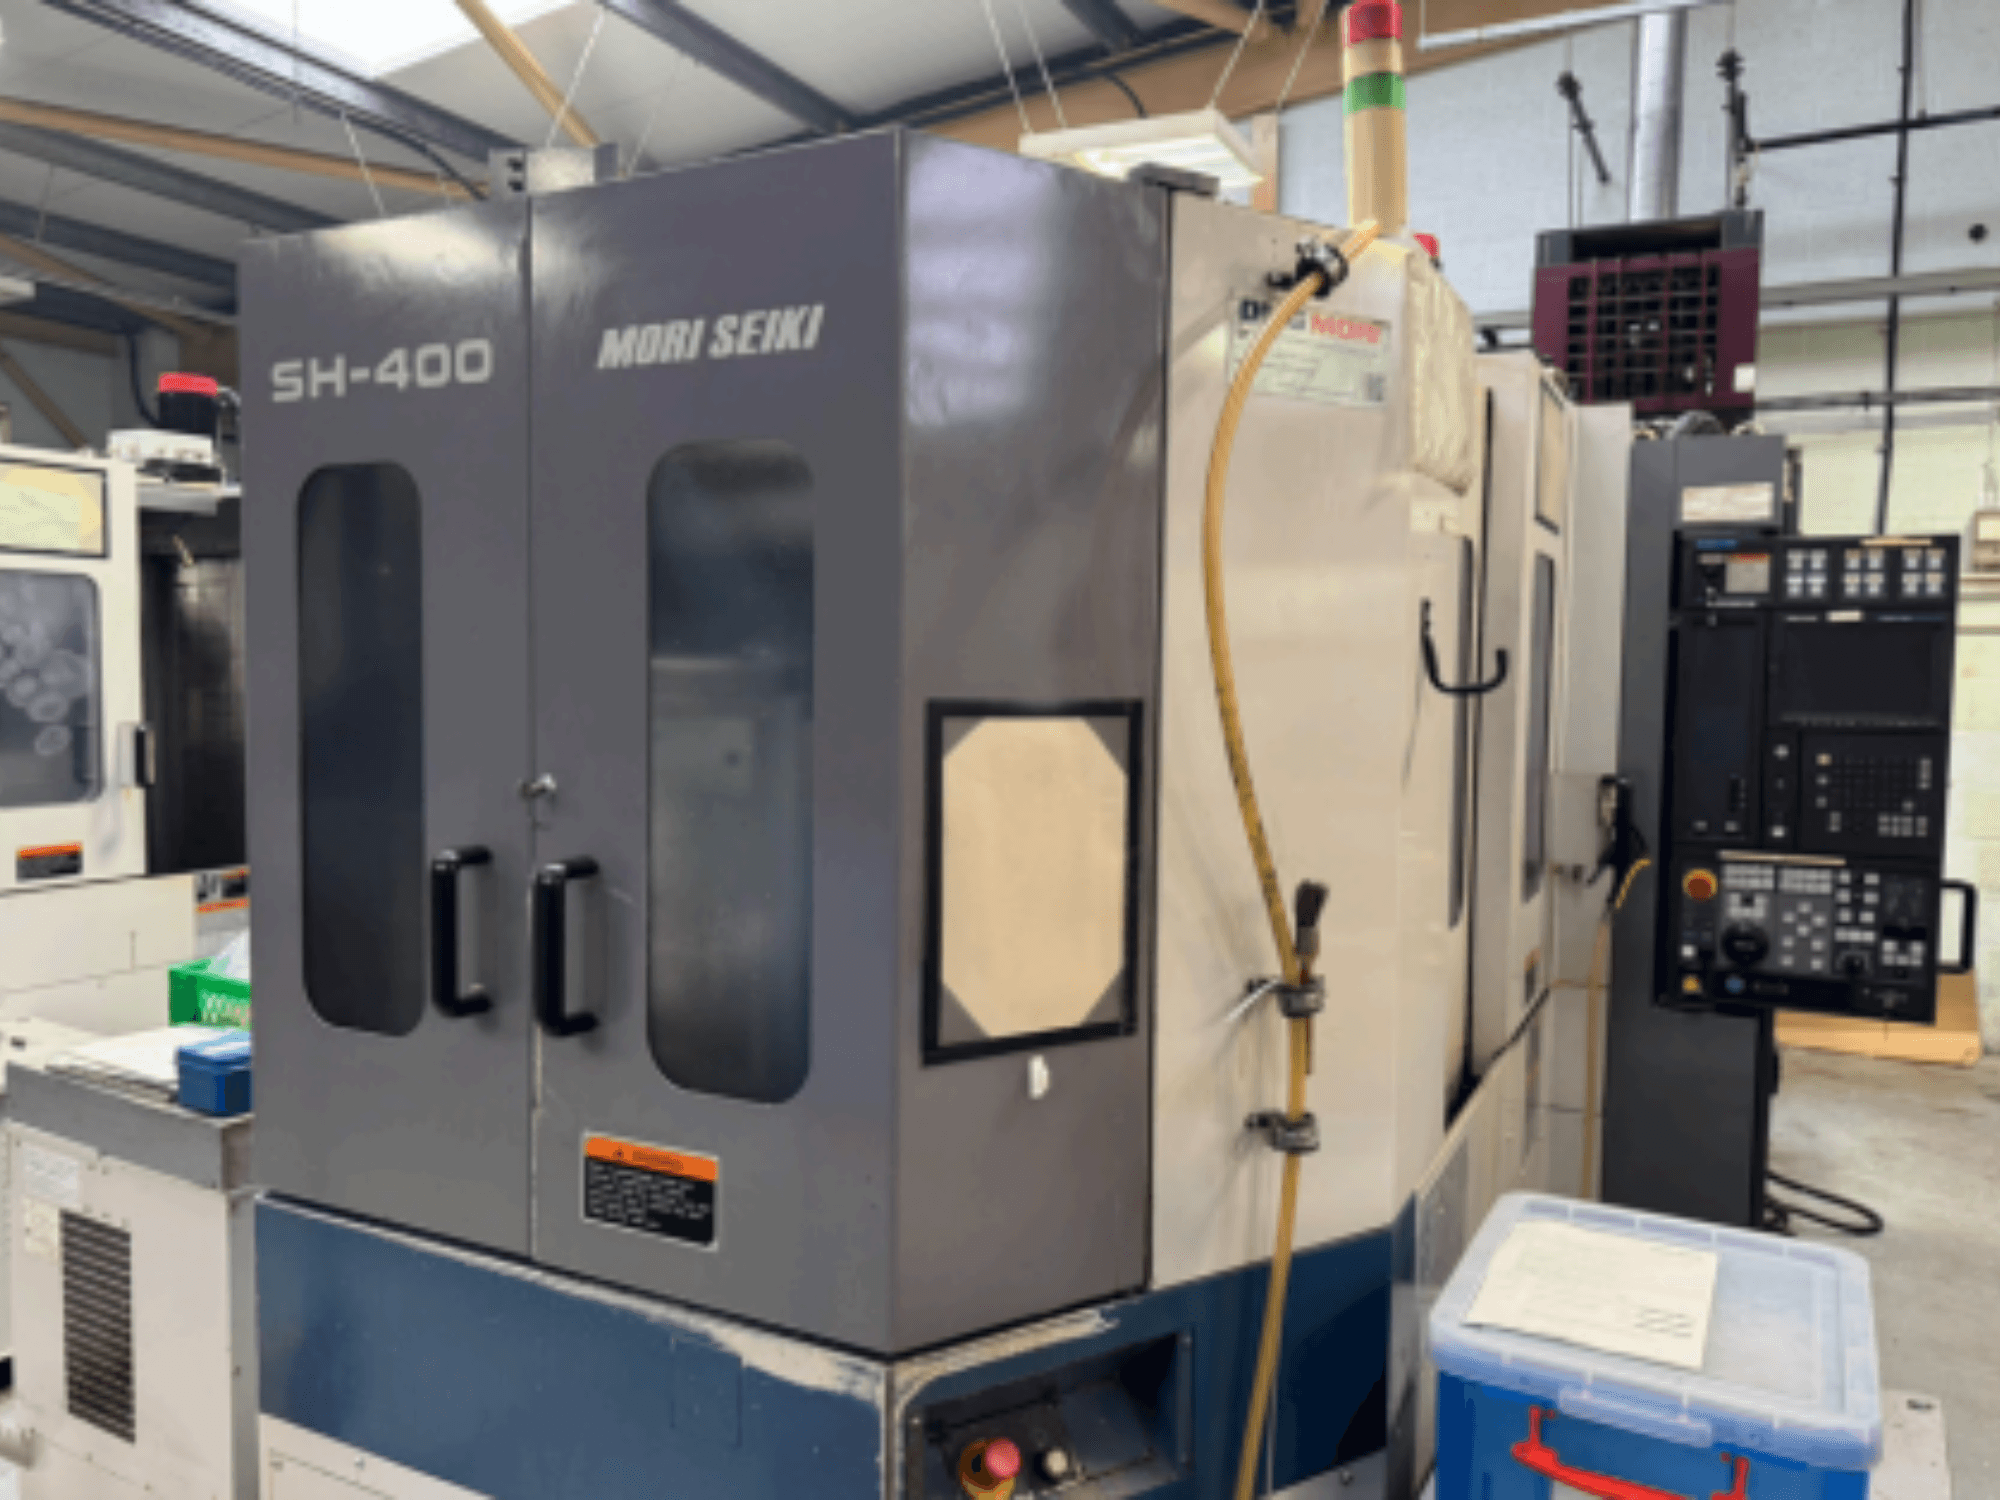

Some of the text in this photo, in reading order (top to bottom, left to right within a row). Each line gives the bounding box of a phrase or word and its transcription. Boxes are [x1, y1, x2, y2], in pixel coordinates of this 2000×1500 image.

[597, 303, 824, 370] MORI SEIKI
[272, 338, 493, 403] SH-400
